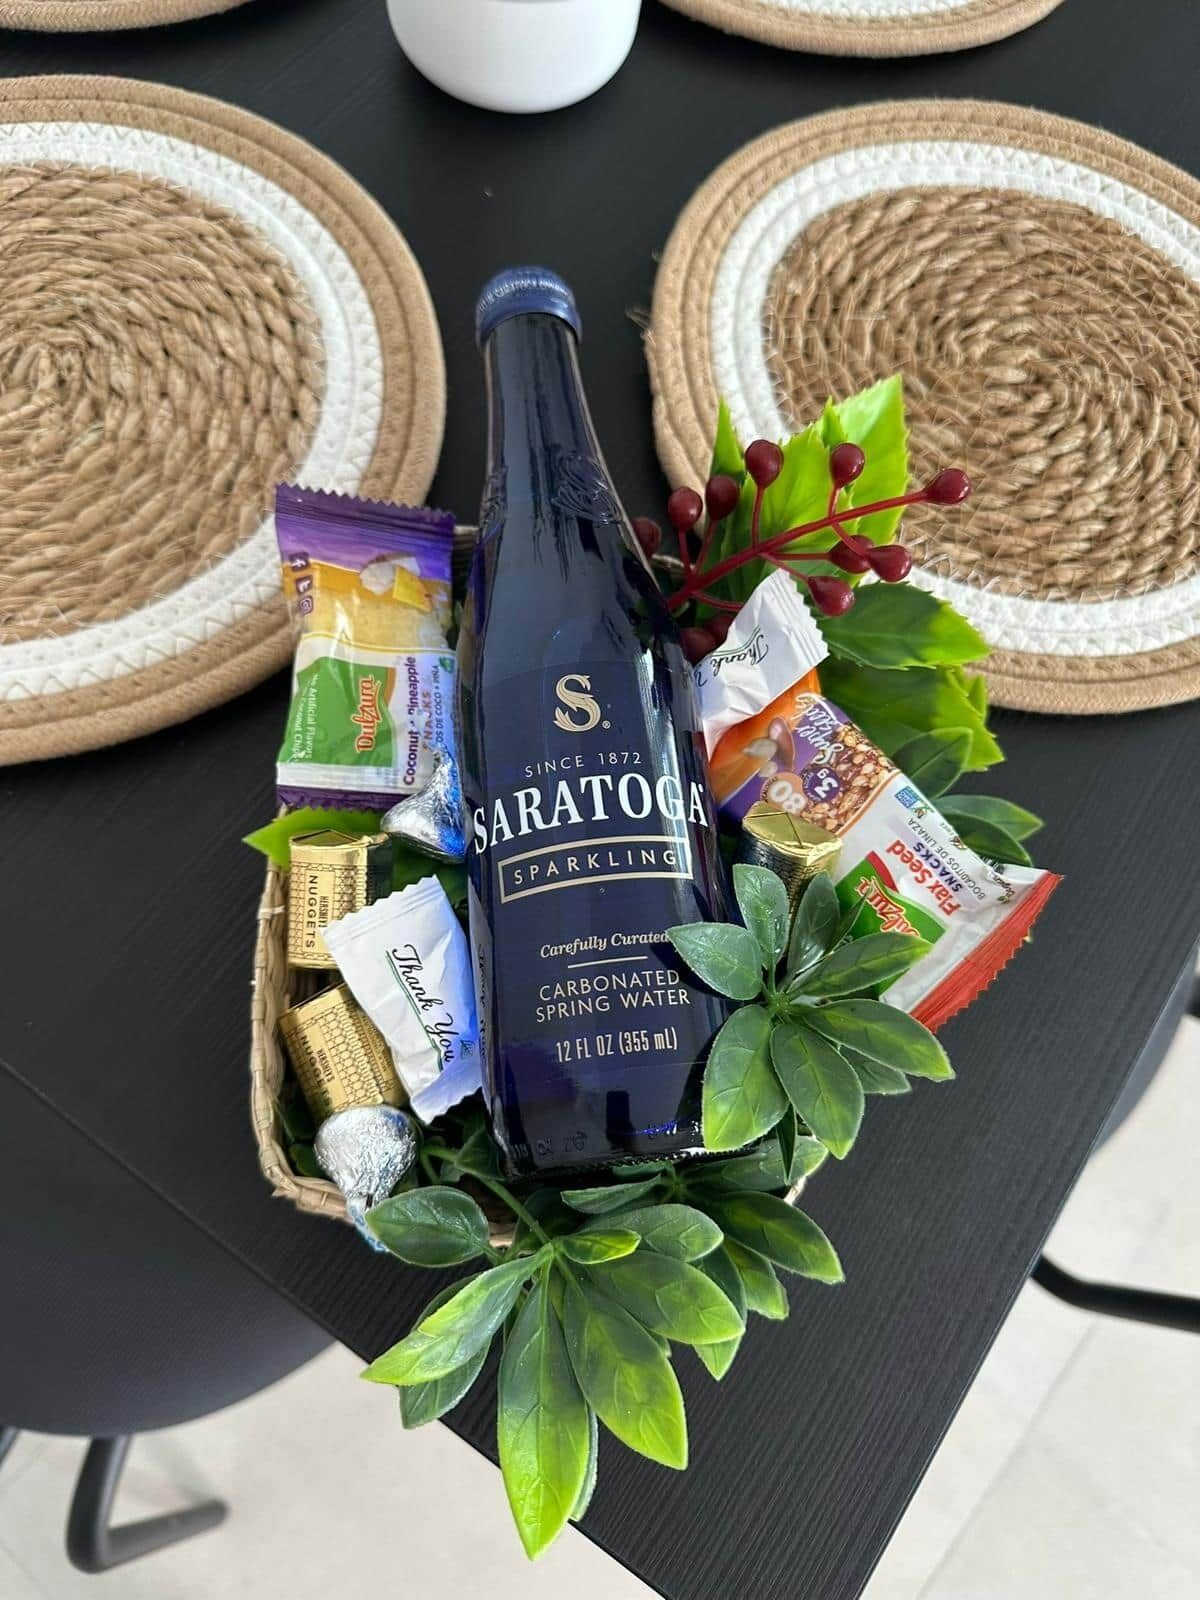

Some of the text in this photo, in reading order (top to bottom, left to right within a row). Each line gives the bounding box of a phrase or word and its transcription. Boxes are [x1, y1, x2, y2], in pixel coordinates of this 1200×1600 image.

[710, 634, 769, 677] Thank
[350, 674, 381, 754] Dulzura
[553, 673, 601, 732] S
[403, 730, 420, 786] Coconut
[525, 752, 642, 778] SINCE 1872
[473, 772, 709, 855] SARATOGA
[769, 778, 807, 814] 80
[907, 818, 938, 847] LINAZA
[514, 849, 678, 885] SPARKLING
[886, 839, 933, 885] Seed
[913, 842, 963, 893] SNACKS
[935, 846, 951, 860] DE
[305, 874, 320, 948] NUGGETS
[925, 883, 961, 917] Flax
[540, 931, 669, 958] Carefully Curated
[392, 944, 459, 1063] Thank You
[539, 969, 680, 1001] CARBONATED
[536, 989, 691, 1023] SPRING WATER
[555, 1026, 678, 1063] 12 FL OZ (355 mL)
